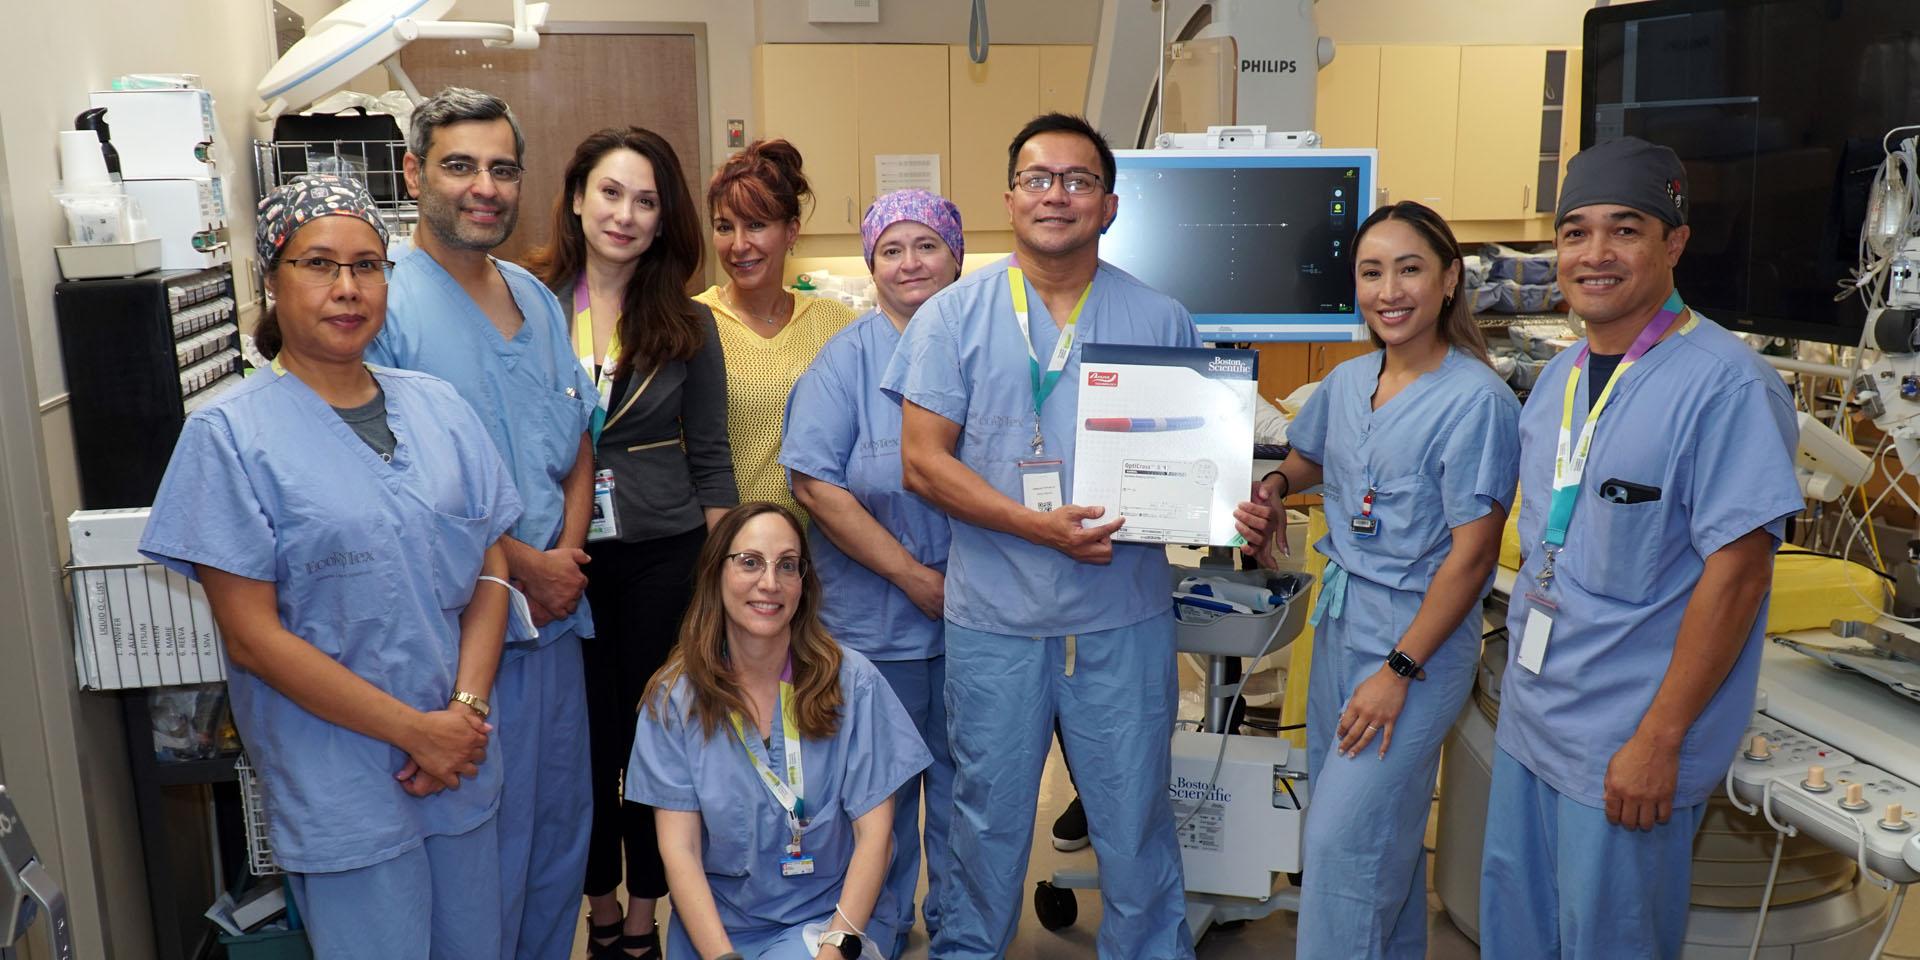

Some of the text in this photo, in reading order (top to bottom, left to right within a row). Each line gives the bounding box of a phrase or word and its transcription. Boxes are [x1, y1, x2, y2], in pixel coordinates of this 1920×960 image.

[1241, 60, 1297, 73] PHILIPS
[1208, 361, 1251, 373] Scientific
[1215, 356, 1241, 366] Boston
[97, 582, 105, 595] LIST
[140, 623, 148, 649] FITSUM
[165, 626, 173, 649] MARIE
[177, 626, 186, 649] REEVA
[202, 632, 211, 649] SIVA
